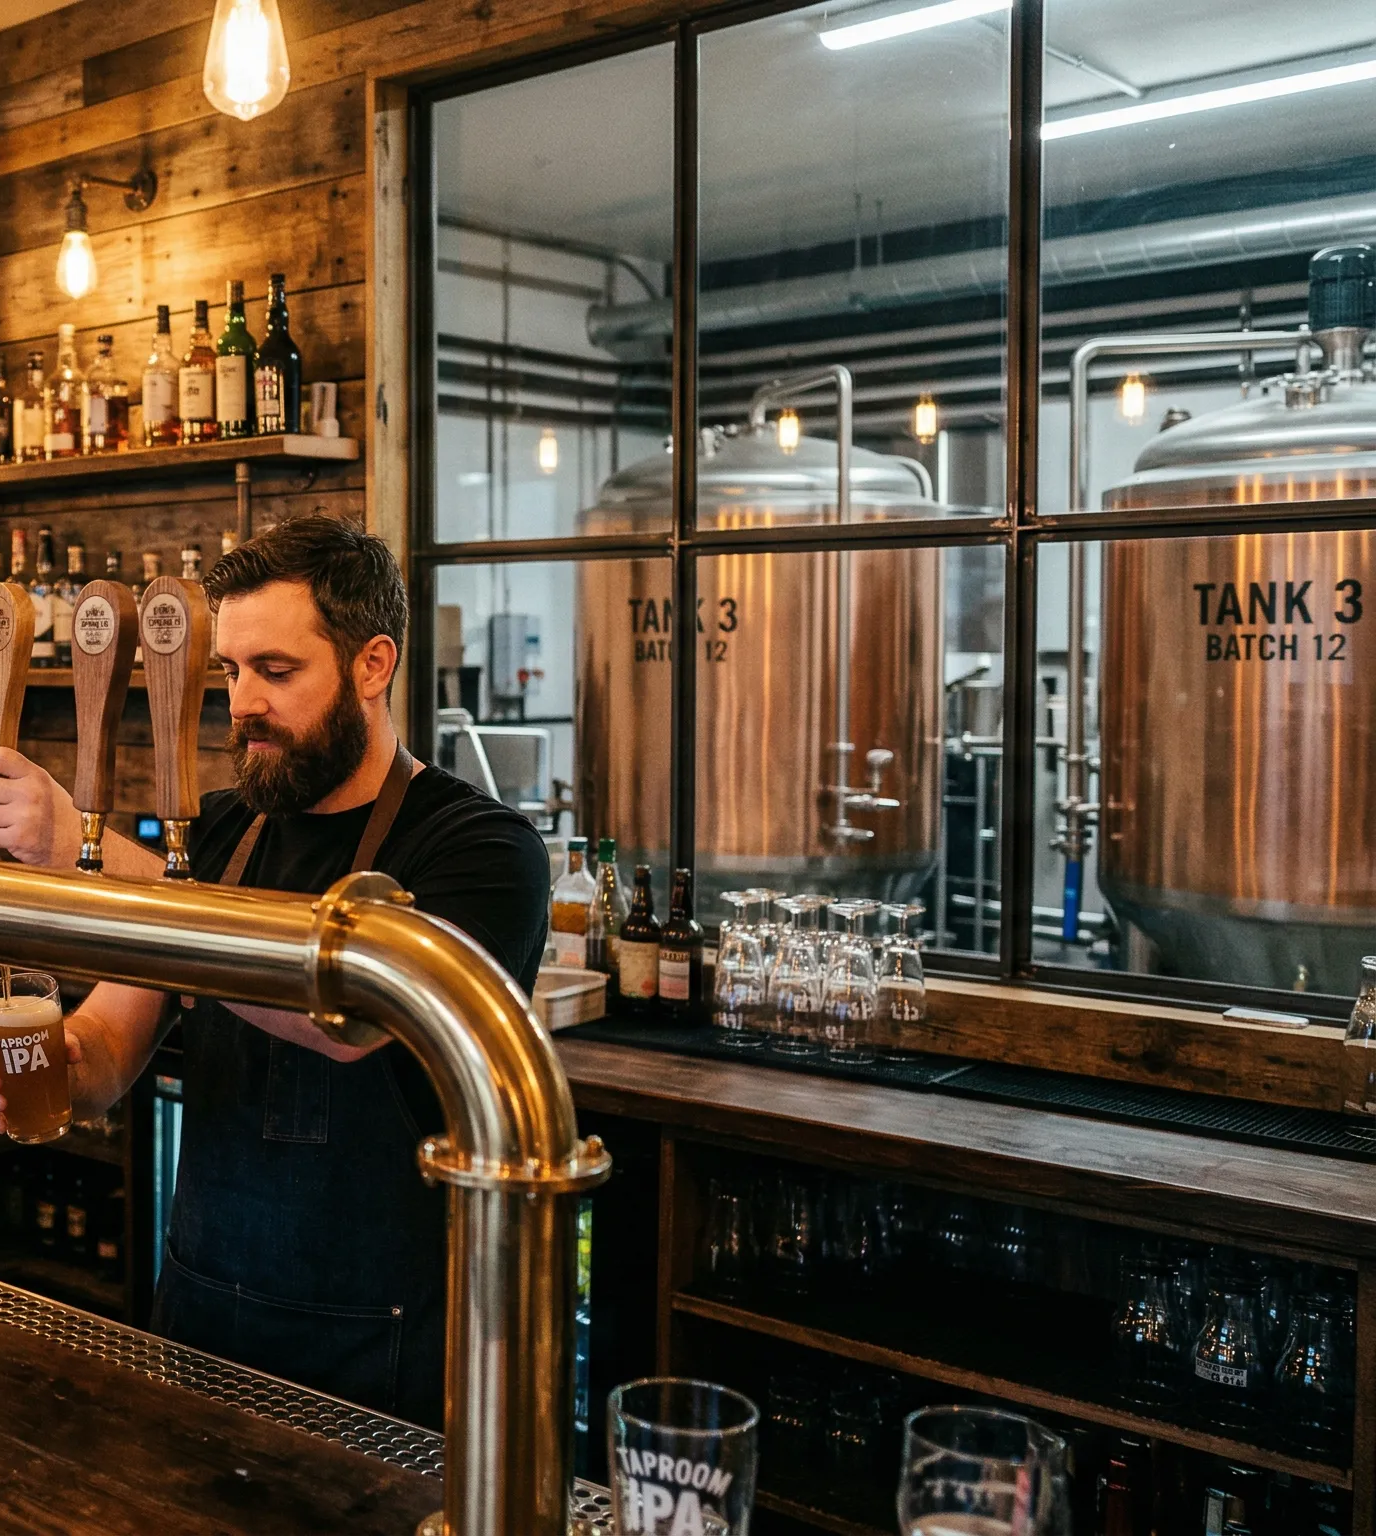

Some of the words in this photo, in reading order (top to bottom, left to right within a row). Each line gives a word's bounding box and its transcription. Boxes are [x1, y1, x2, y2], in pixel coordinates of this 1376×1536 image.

[718, 598, 738, 633] 3
[1193, 580, 1313, 625] TANK
[1334, 579, 1363, 624] 3
[706, 640, 728, 662] 12
[1206, 633, 1298, 661] BATCH
[1313, 633, 1347, 661] 12
[2, 1043, 50, 1074] IPA
[616, 1447, 733, 1499] TAPROOM
[626, 1477, 705, 1536] IPA
